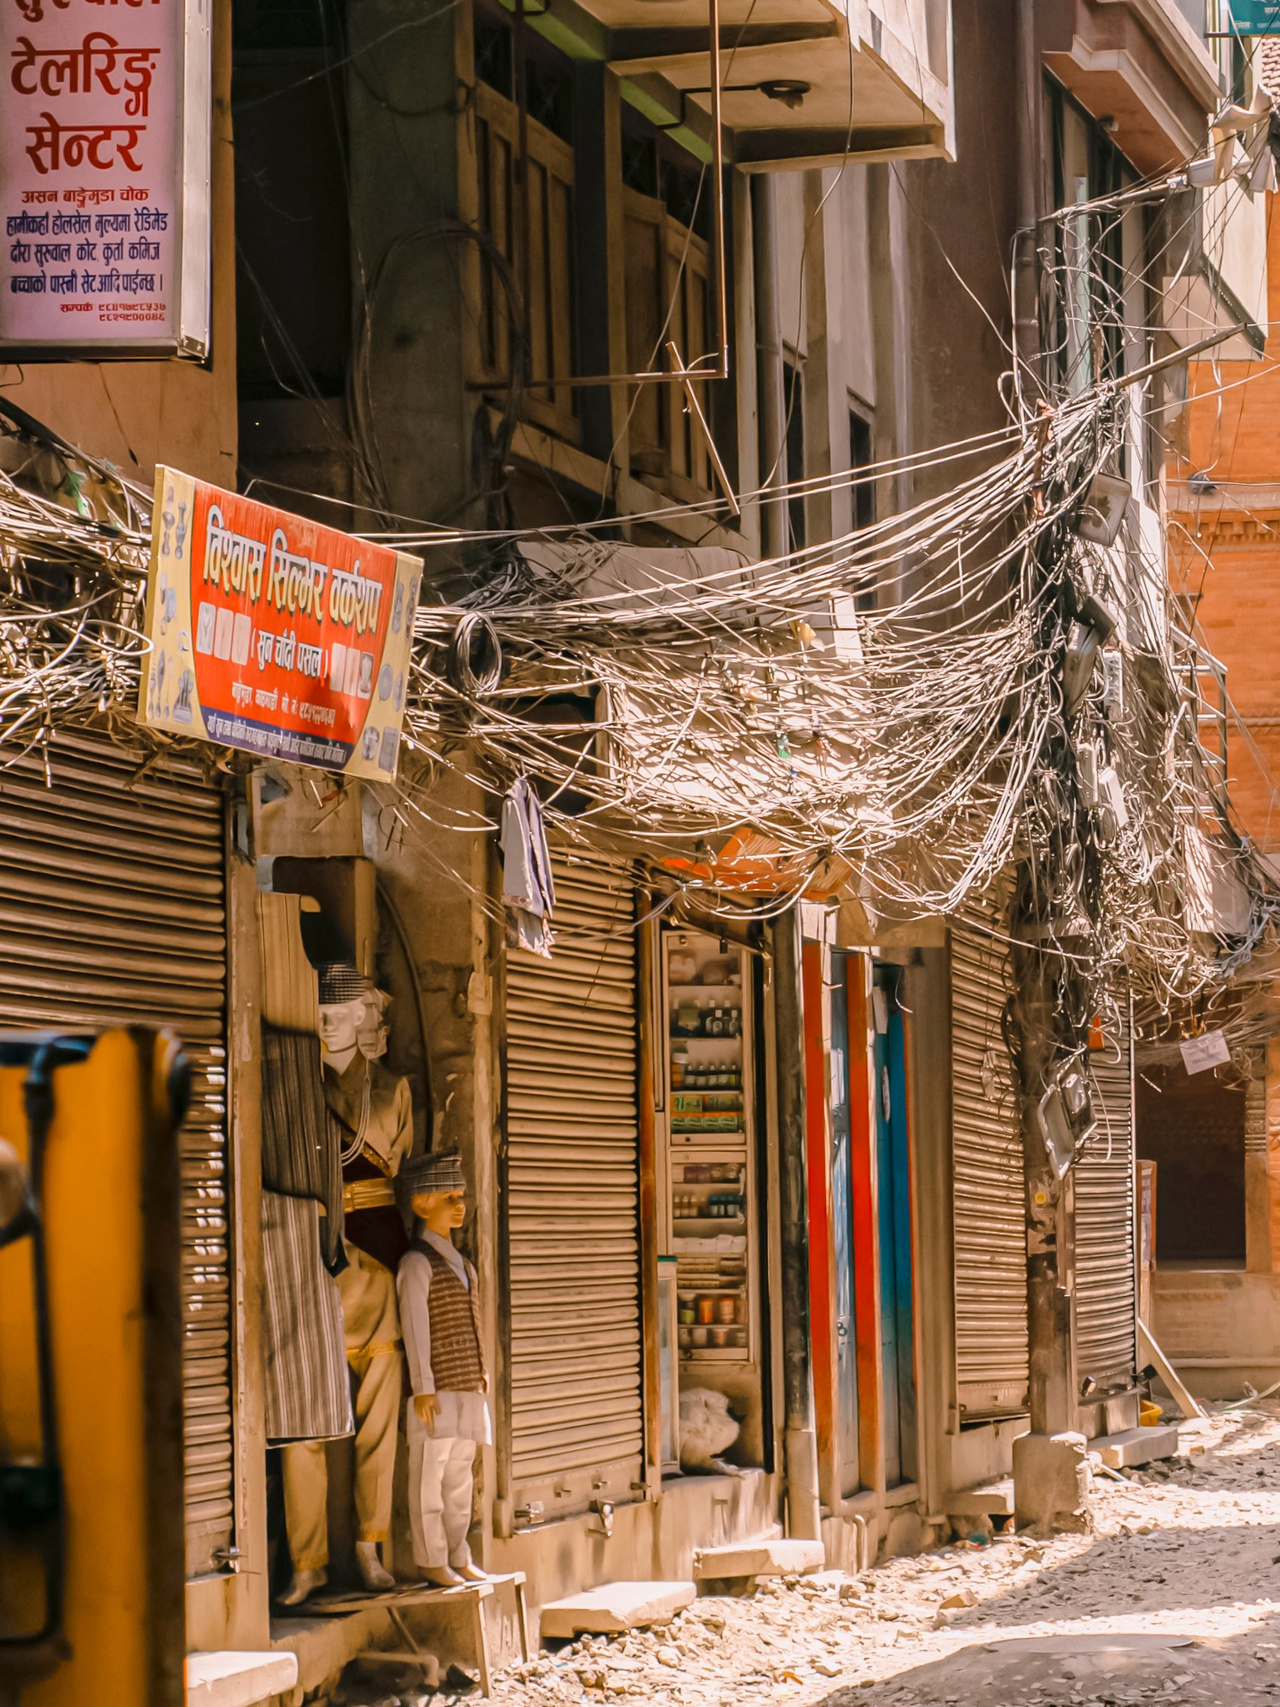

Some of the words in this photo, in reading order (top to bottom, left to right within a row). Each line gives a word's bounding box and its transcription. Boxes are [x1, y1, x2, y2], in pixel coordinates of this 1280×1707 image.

[11, 31, 161, 117] टेलरिङ्ग
[25, 112, 147, 175] सेन्टर
[22, 190, 58, 203] असन
[120, 186, 149, 201] चोक
[52, 210, 91, 235] होलसेल
[134, 207, 168, 232] रेडिमेड
[128, 236, 160, 262] कमिज
[81, 269, 97, 294] सेट
